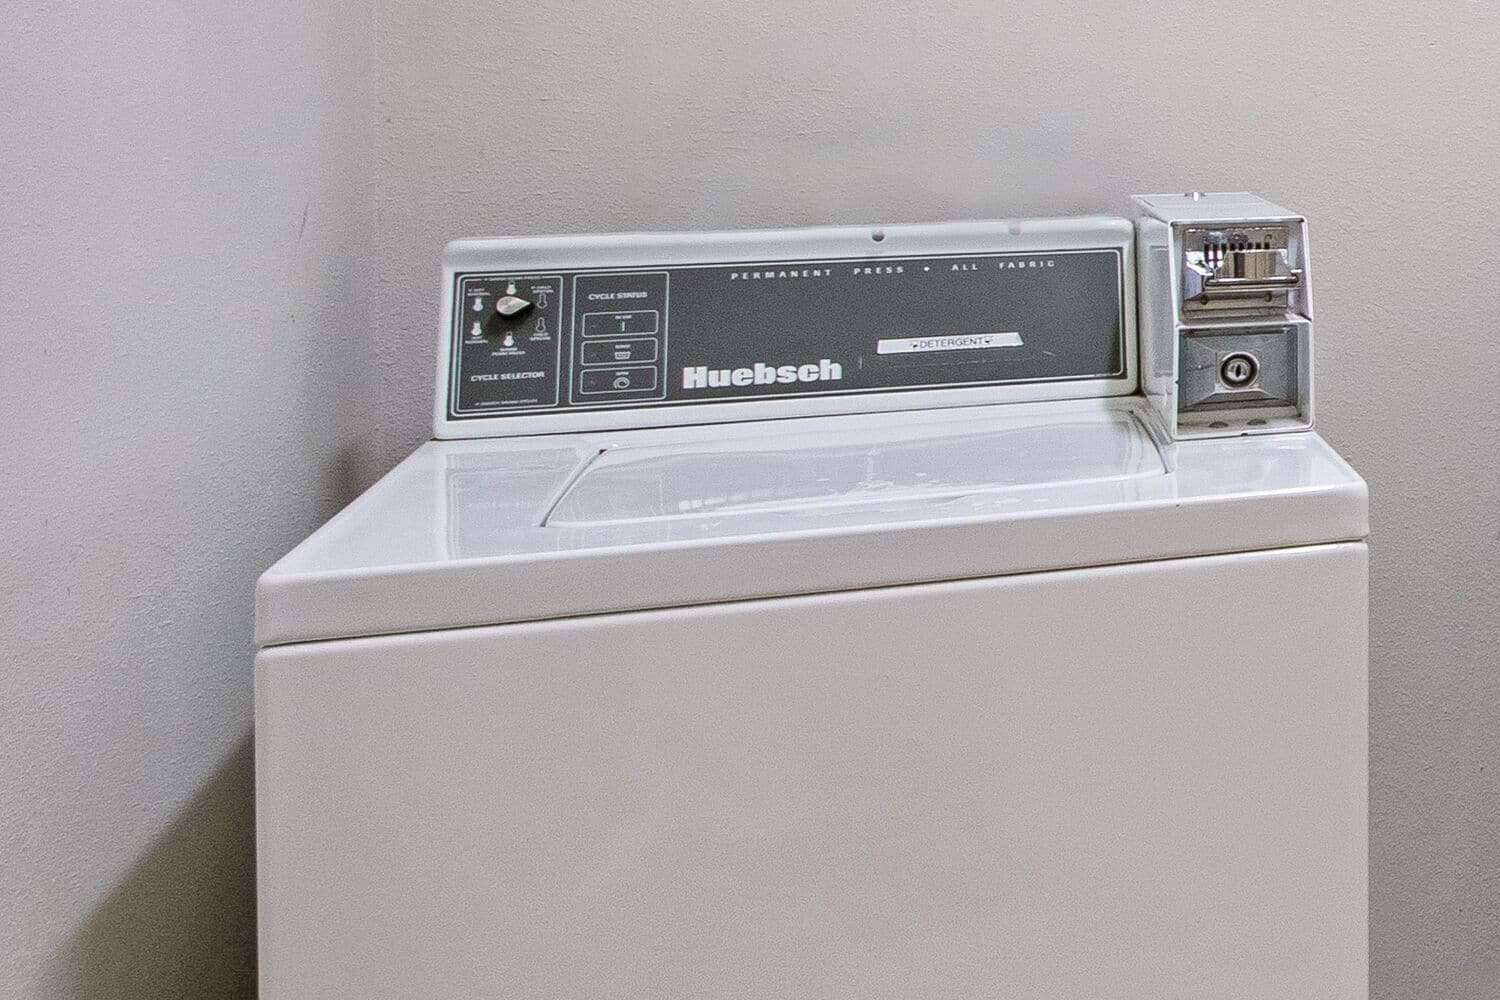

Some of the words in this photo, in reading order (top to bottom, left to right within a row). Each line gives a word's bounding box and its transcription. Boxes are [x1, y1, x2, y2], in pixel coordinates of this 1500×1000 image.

[731, 268, 833, 281] PERMANENT
[853, 266, 905, 276] PRESS
[951, 262, 979, 272] ALL
[1000, 259, 1056, 270] FABRIC
[588, 292, 615, 301] CYCLE
[616, 291, 649, 300] STATUS
[919, 336, 985, 349] DETERGENT
[471, 373, 499, 383] CYCLE
[500, 371, 546, 381] SELECTOR
[683, 359, 842, 389] Huebsch
